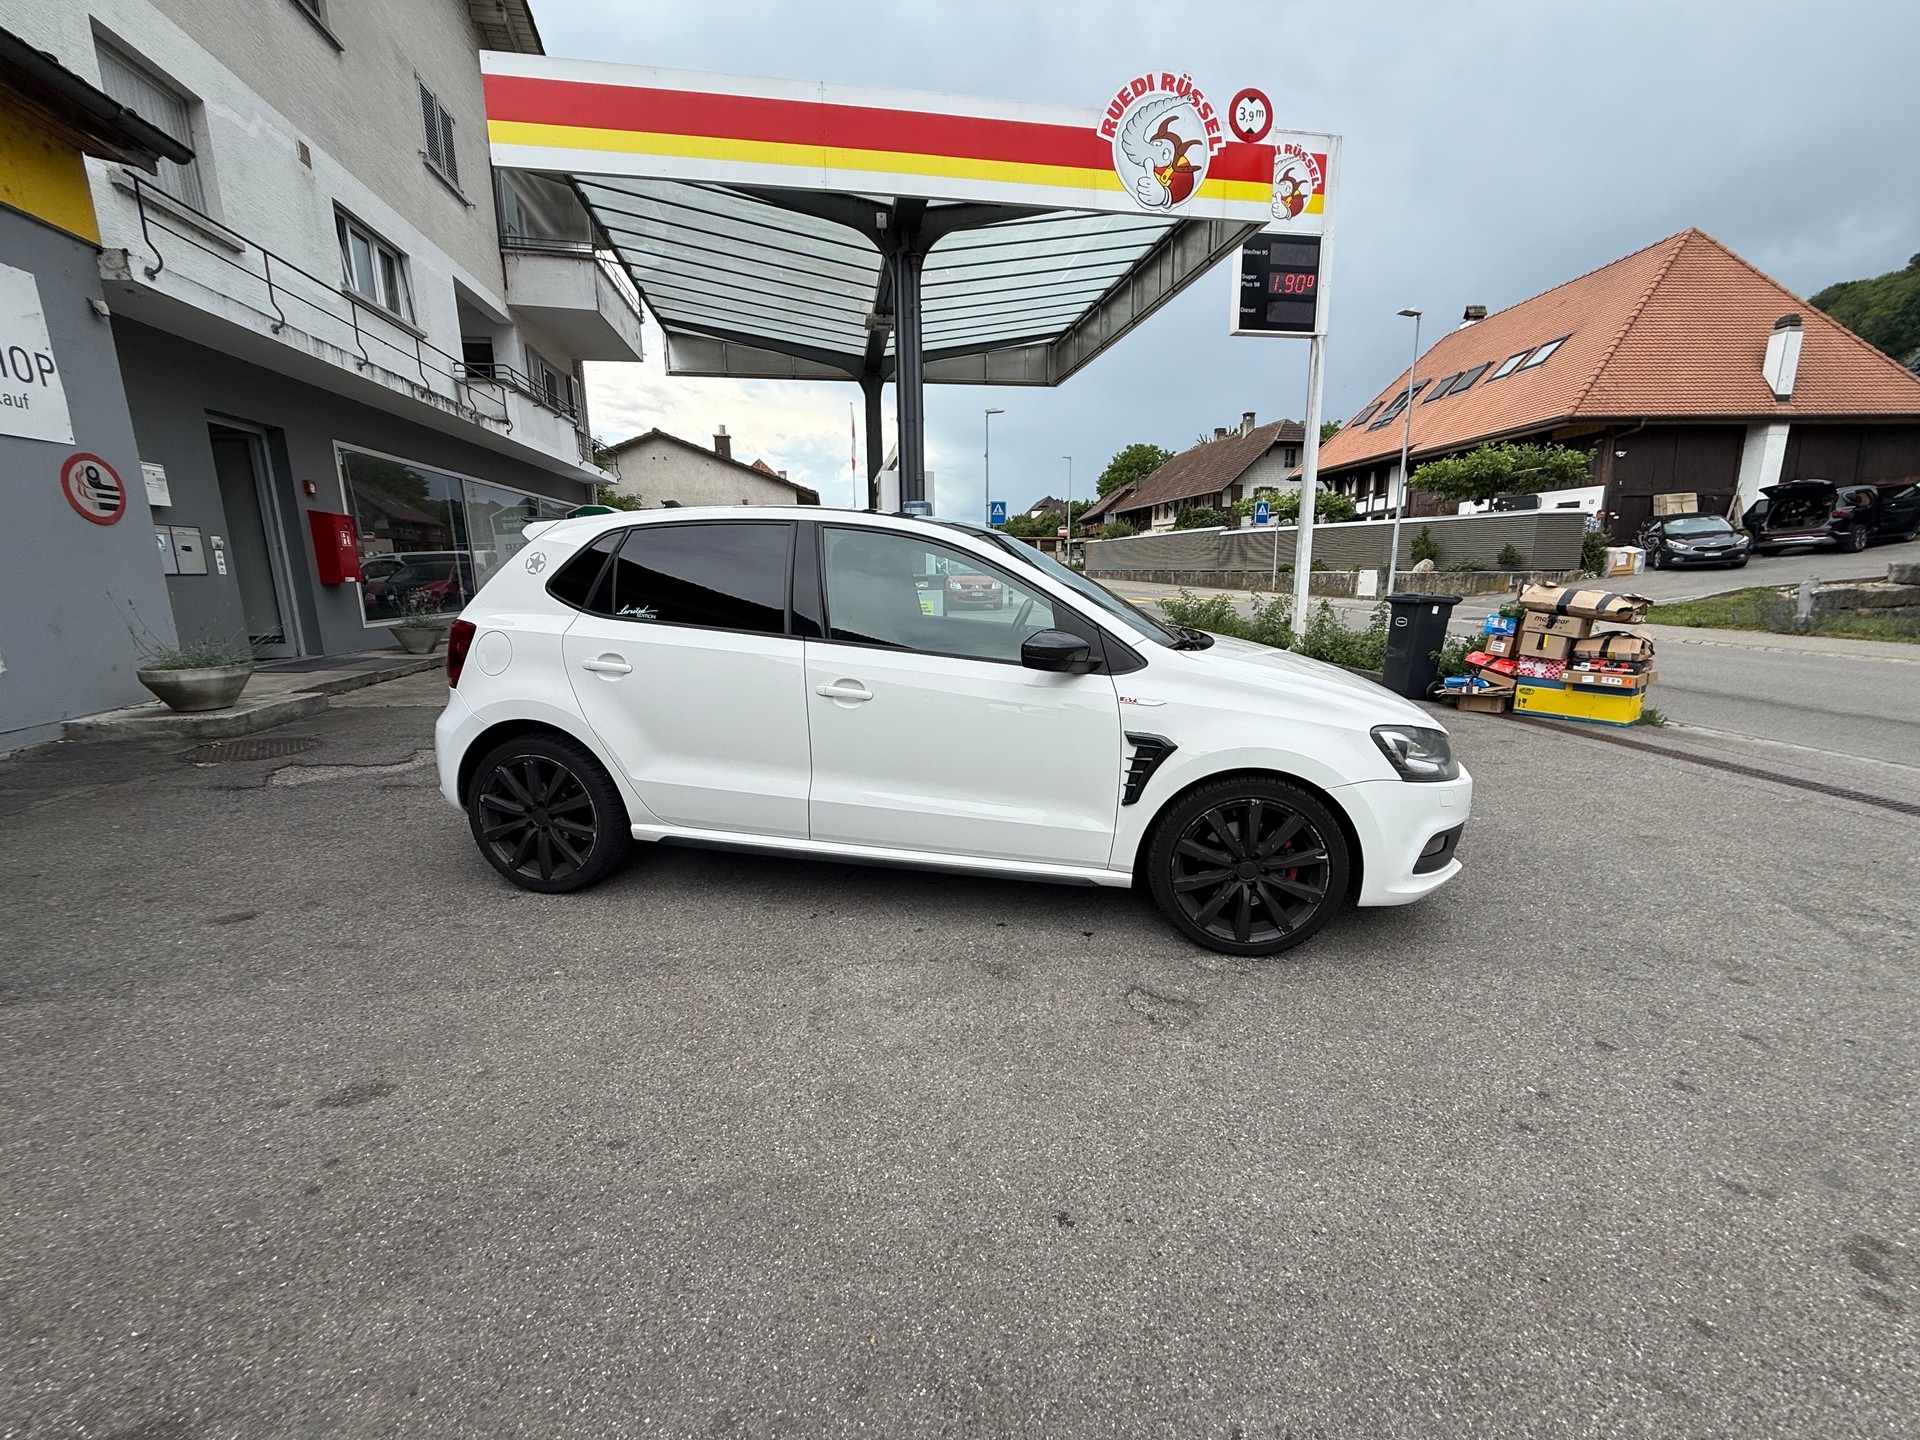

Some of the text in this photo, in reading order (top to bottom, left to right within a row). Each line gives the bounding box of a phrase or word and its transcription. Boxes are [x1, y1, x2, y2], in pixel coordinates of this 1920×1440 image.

[1100, 72, 1223, 152] RUEDI RÜSSEL
[1284, 143, 1319, 187] RÜSSEL
